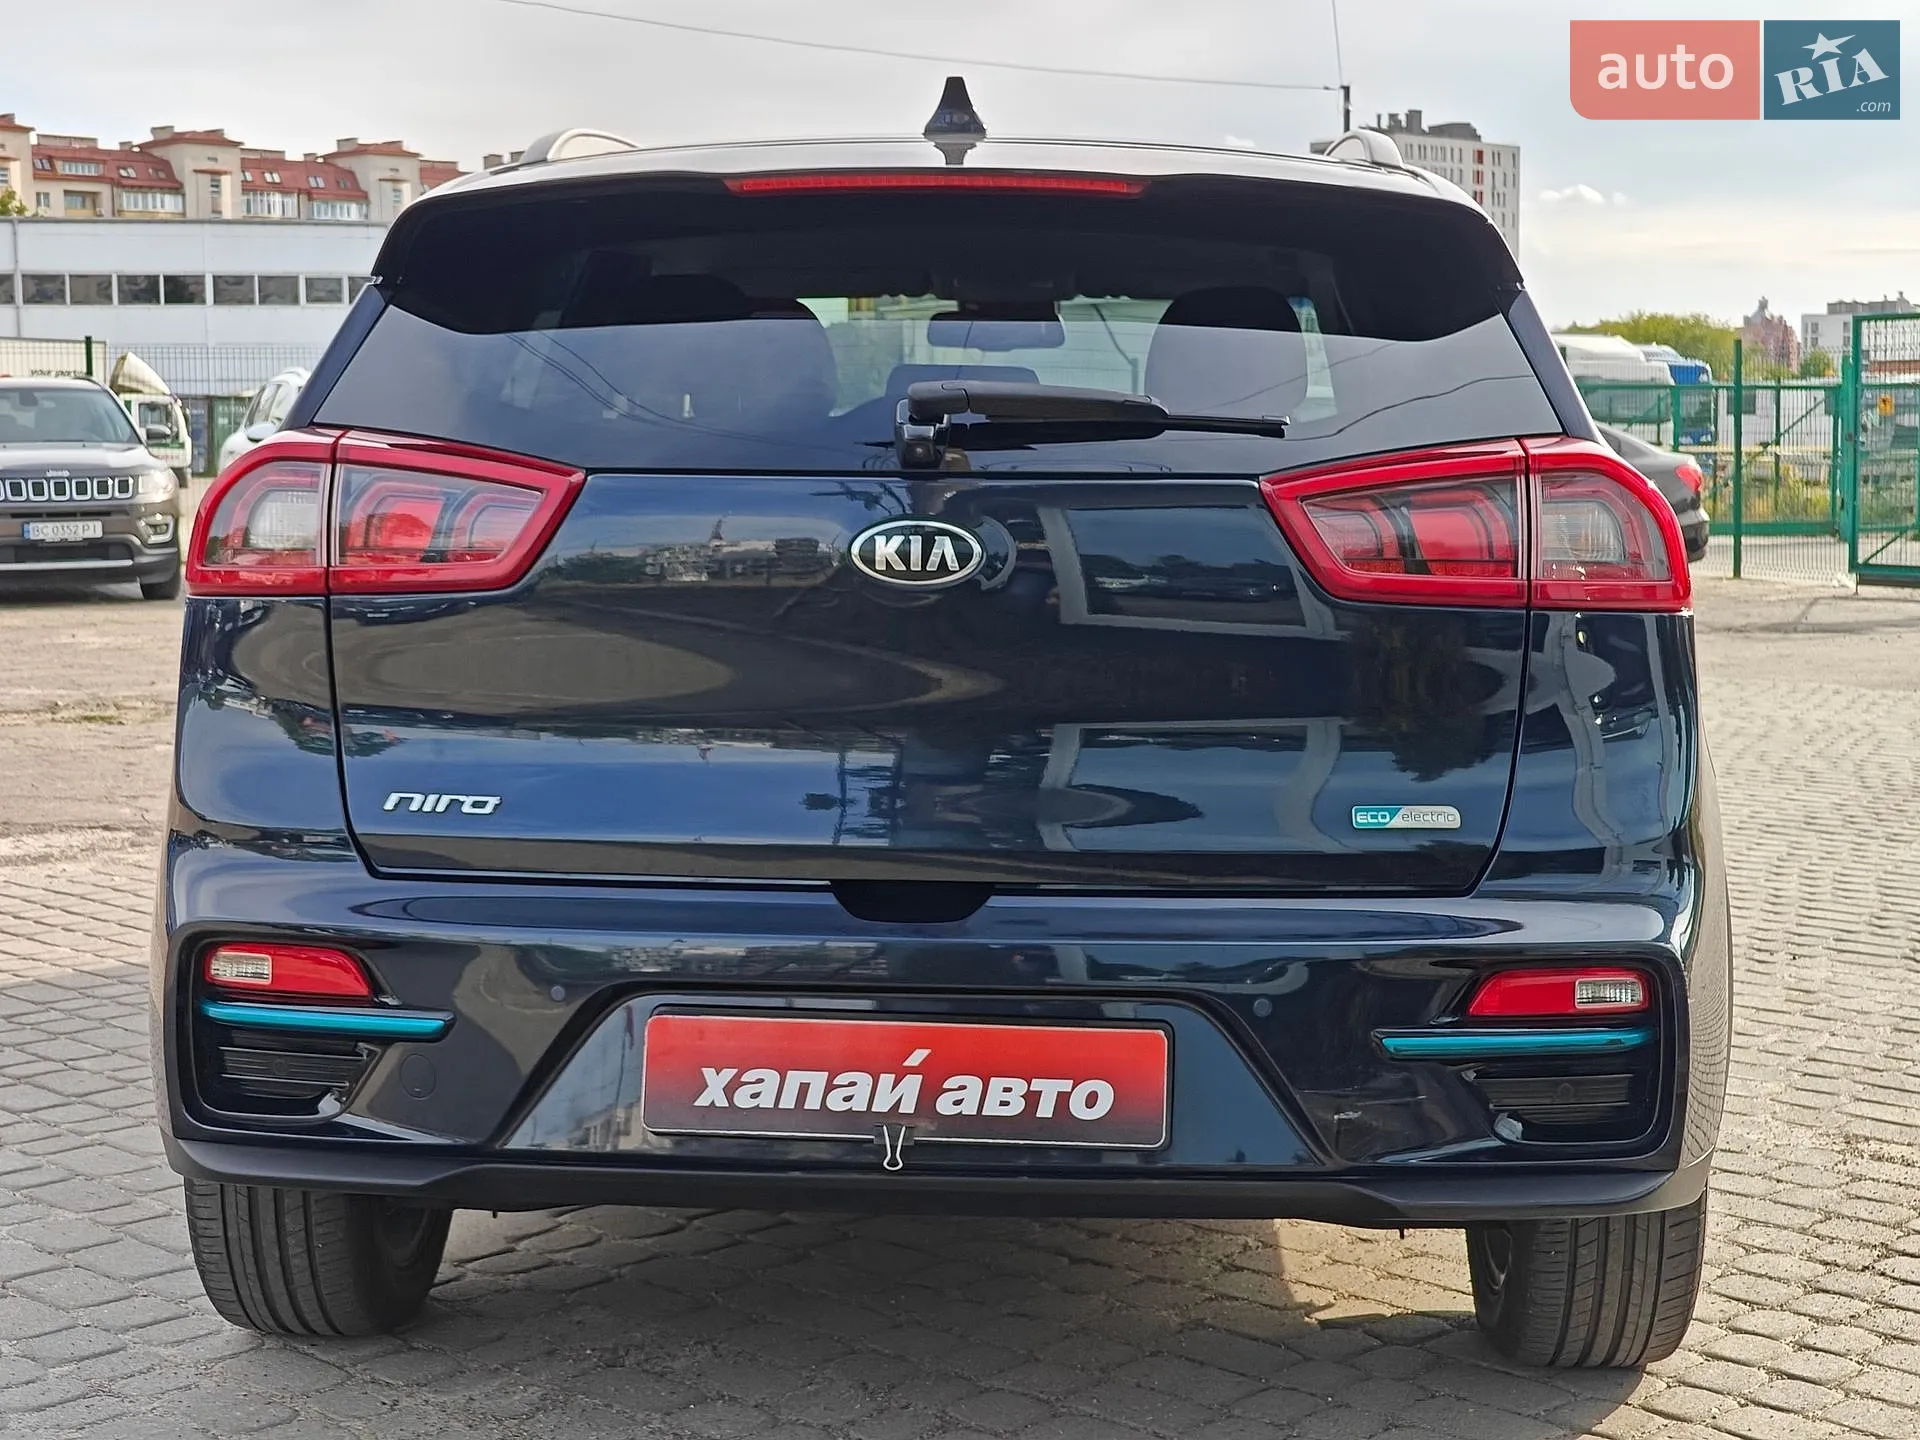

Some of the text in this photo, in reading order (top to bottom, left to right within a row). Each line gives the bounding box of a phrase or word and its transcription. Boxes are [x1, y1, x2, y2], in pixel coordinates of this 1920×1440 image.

[874, 535, 960, 571] KIA
[1356, 811, 1457, 824] ECO electric
[693, 1049, 1115, 1120] хапай авто
